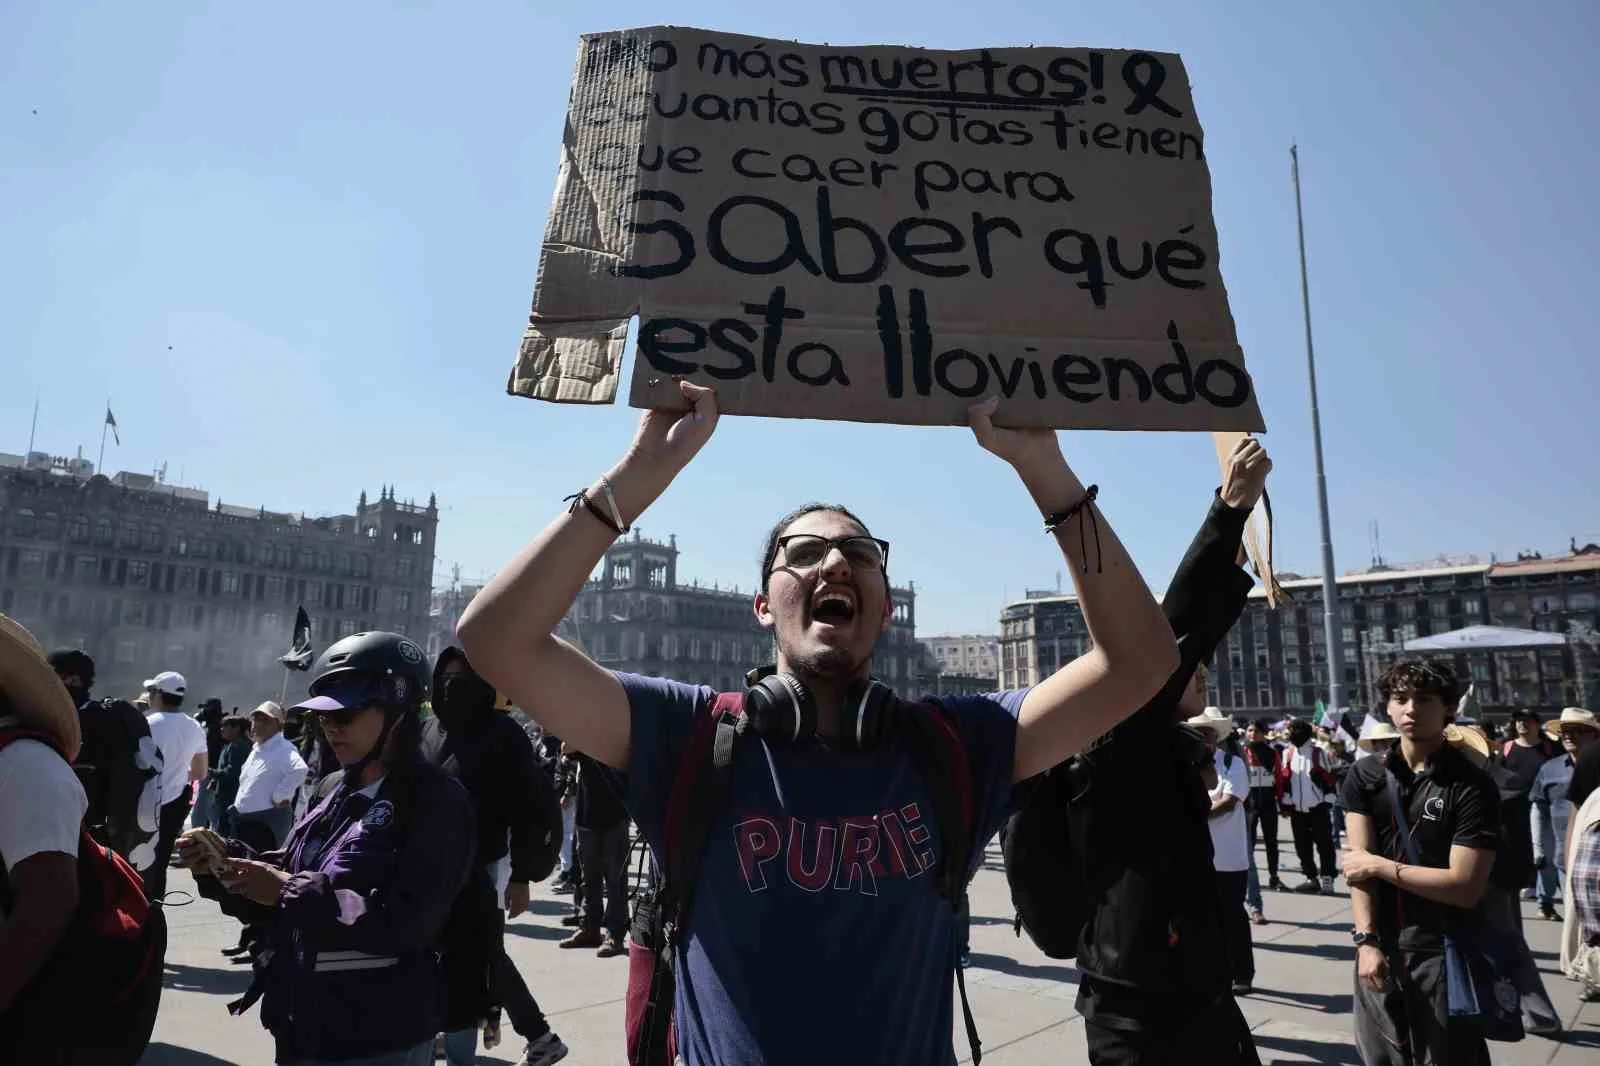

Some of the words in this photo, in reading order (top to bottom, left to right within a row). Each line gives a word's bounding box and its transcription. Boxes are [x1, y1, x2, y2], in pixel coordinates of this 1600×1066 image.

[699, 41, 809, 87] más
[820, 49, 1106, 104] muertos!
[858, 103, 1034, 154] gotas
[1040, 109, 1205, 161] tienen
[732, 147, 898, 189] caer
[914, 160, 1076, 211] para
[1043, 223, 1207, 309] qué
[637, 285, 850, 386] esta
[876, 283, 1251, 408] lloviendo
